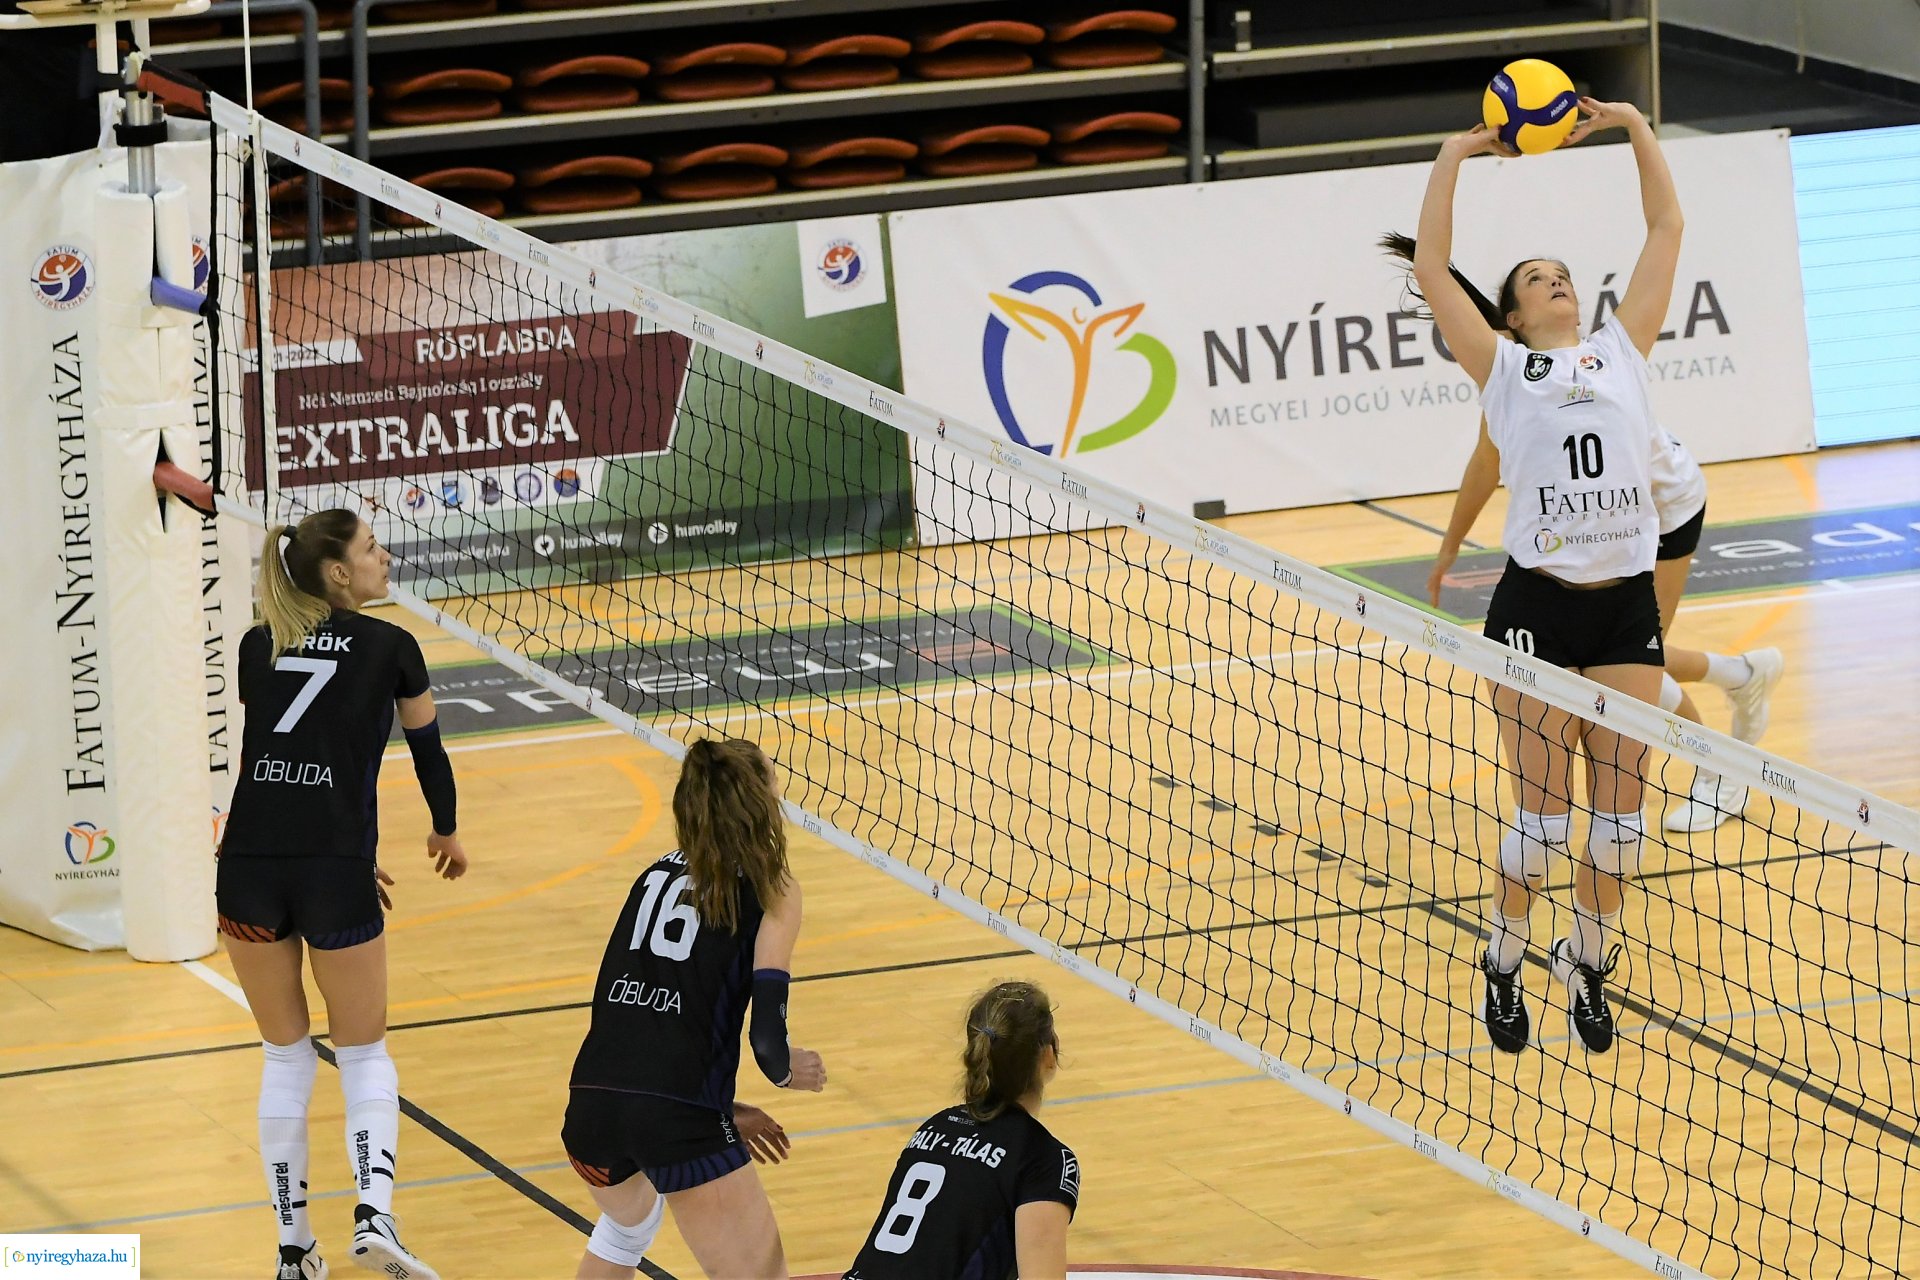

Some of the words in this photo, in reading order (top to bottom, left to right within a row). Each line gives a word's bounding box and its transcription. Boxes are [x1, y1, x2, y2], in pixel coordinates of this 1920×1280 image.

[416, 325, 577, 364] RÖPLABDA
[692, 314, 716, 341] FATUM
[1203, 273, 1731, 387] NYÍREÁA
[331, 384, 394, 407] Nemzeti
[398, 378, 478, 401] Bajnokság
[869, 389, 894, 417] FATUM
[1210, 400, 1308, 428] MEGYEI
[1321, 385, 1390, 418] JOGÚ
[1401, 381, 1483, 408] VÁRO
[277, 399, 580, 472] EXTRALIGA
[1563, 432, 1605, 480] 10
[1061, 471, 1089, 500] FATUM
[1535, 483, 1641, 517] FATUM
[1538, 507, 1641, 525] PROPERTY
[1565, 527, 1642, 546] NYÍREGYHÁZA
[48, 331, 107, 797] FATUM-NYÍREGYHÁZA
[1273, 559, 1302, 590] FATUM
[1505, 627, 1536, 657] 10
[1505, 655, 1537, 687] FATUM
[273, 656, 338, 733] 7
[253, 753, 333, 788] ÓBUDA
[1762, 759, 1797, 794] FATUM
[55, 868, 120, 881] NYÍREGYHÁZ
[629, 870, 701, 962] 16
[987, 911, 1008, 936] FATUM
[608, 973, 681, 1015] ÓBUDA
[1189, 1017, 1212, 1042] FATUM
[354, 1129, 371, 1190] ninesquared
[951, 1132, 1007, 1169] TÁLAS
[1413, 1133, 1438, 1161] FATUM
[272, 1161, 294, 1226] ninesquared
[874, 1161, 947, 1255] 8
[1655, 1254, 1683, 1280] FATUM
